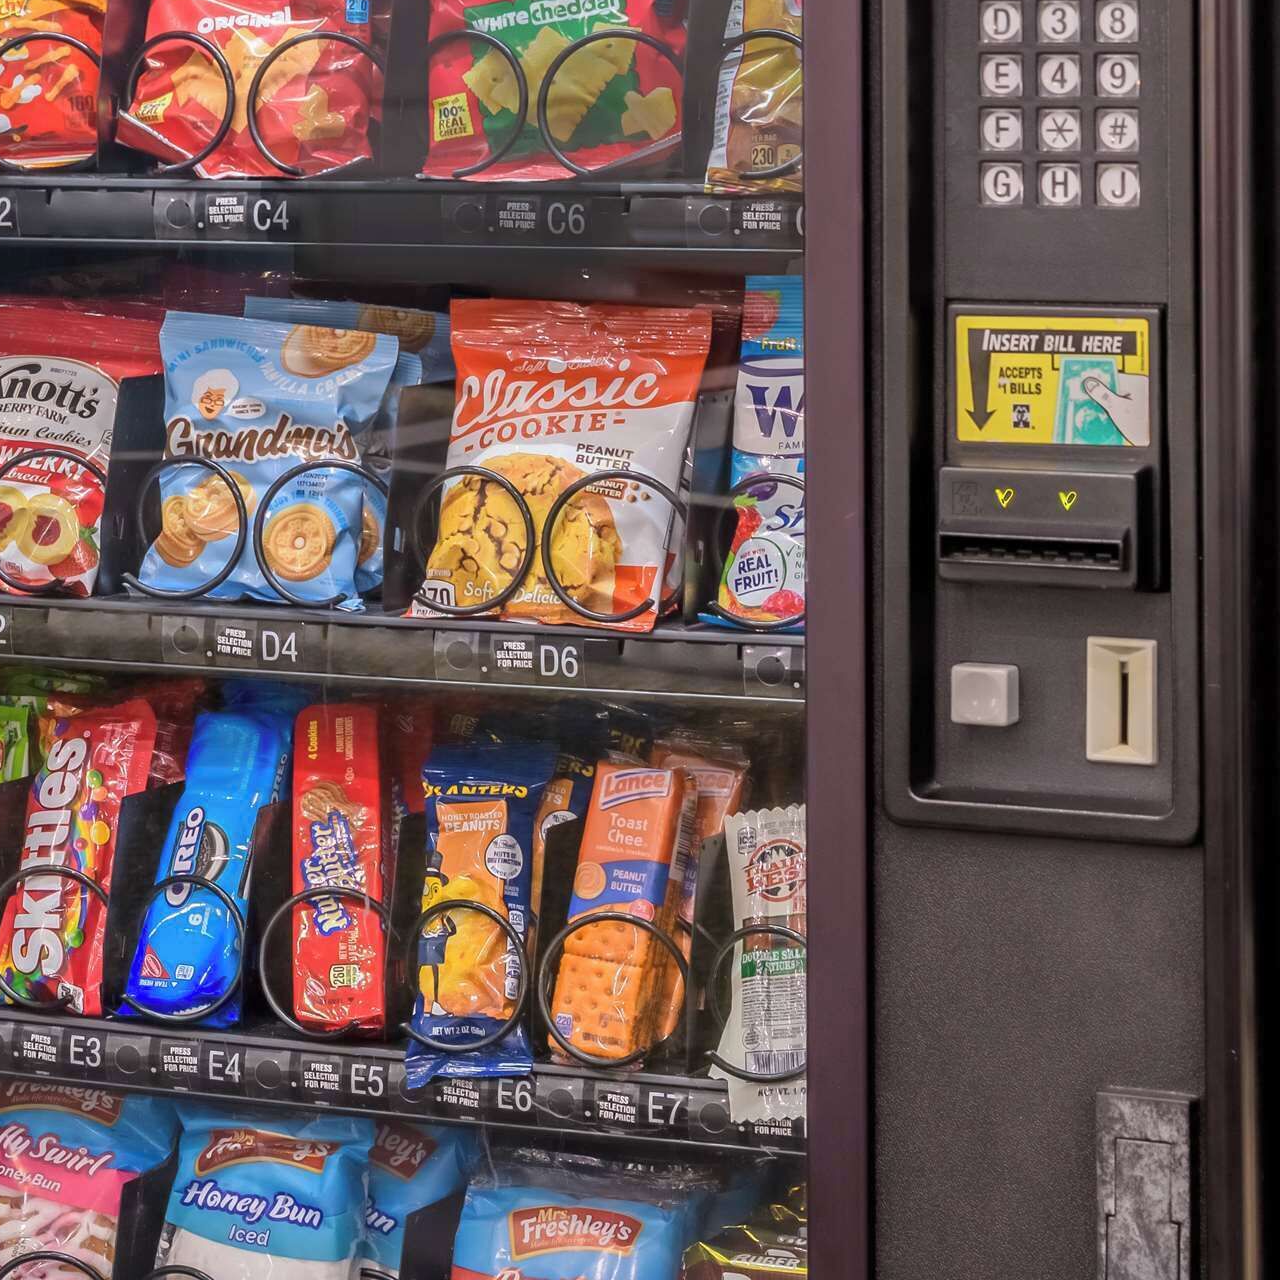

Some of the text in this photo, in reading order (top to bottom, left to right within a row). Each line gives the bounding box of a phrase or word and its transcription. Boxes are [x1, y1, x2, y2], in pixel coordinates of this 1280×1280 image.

[438, 105, 466, 119] 100%
[438, 118, 465, 129] REAL
[751, 146, 775, 166] 230
[994, 171, 1010, 197] G
[1052, 171, 1068, 198] H
[1112, 171, 1126, 198] J
[253, 200, 289, 231] C4
[547, 203, 585, 235] C6
[981, 329, 1123, 353] INSERT BILL HERE
[998, 366, 1043, 380] ACCEPTS
[454, 359, 661, 435] Classic
[1010, 383, 1042, 395] BILLS
[35, 405, 67, 424] FARM
[35, 426, 92, 447] Cookies
[165, 414, 357, 464] Grandma's
[479, 411, 608, 449] COOKIE
[575, 455, 631, 471] BUTTER
[576, 442, 635, 460] PEANUT
[738, 555, 772, 576] REAL
[734, 572, 780, 594] FRUIT!
[263, 631, 298, 662] D4
[540, 646, 578, 678] D6
[604, 772, 665, 798] Lance
[445, 819, 501, 833] PEANUTS
[609, 812, 649, 832] Toast
[608, 828, 643, 847] Chee
[613, 868, 647, 881] PEANUT
[610, 882, 643, 894] BUTTER
[70, 1035, 101, 1066] E3
[209, 1050, 240, 1082] E4
[351, 1064, 383, 1096] E5
[497, 1080, 532, 1111] E6
[648, 1092, 684, 1125] E7
[29, 1136, 113, 1176] Swirl
[31, 1173, 62, 1193] Bun
[184, 1182, 322, 1227] Honey Bun
[537, 1207, 570, 1222] Mrs.
[228, 1223, 271, 1247] Iced
[520, 1214, 633, 1246] Freshley's
